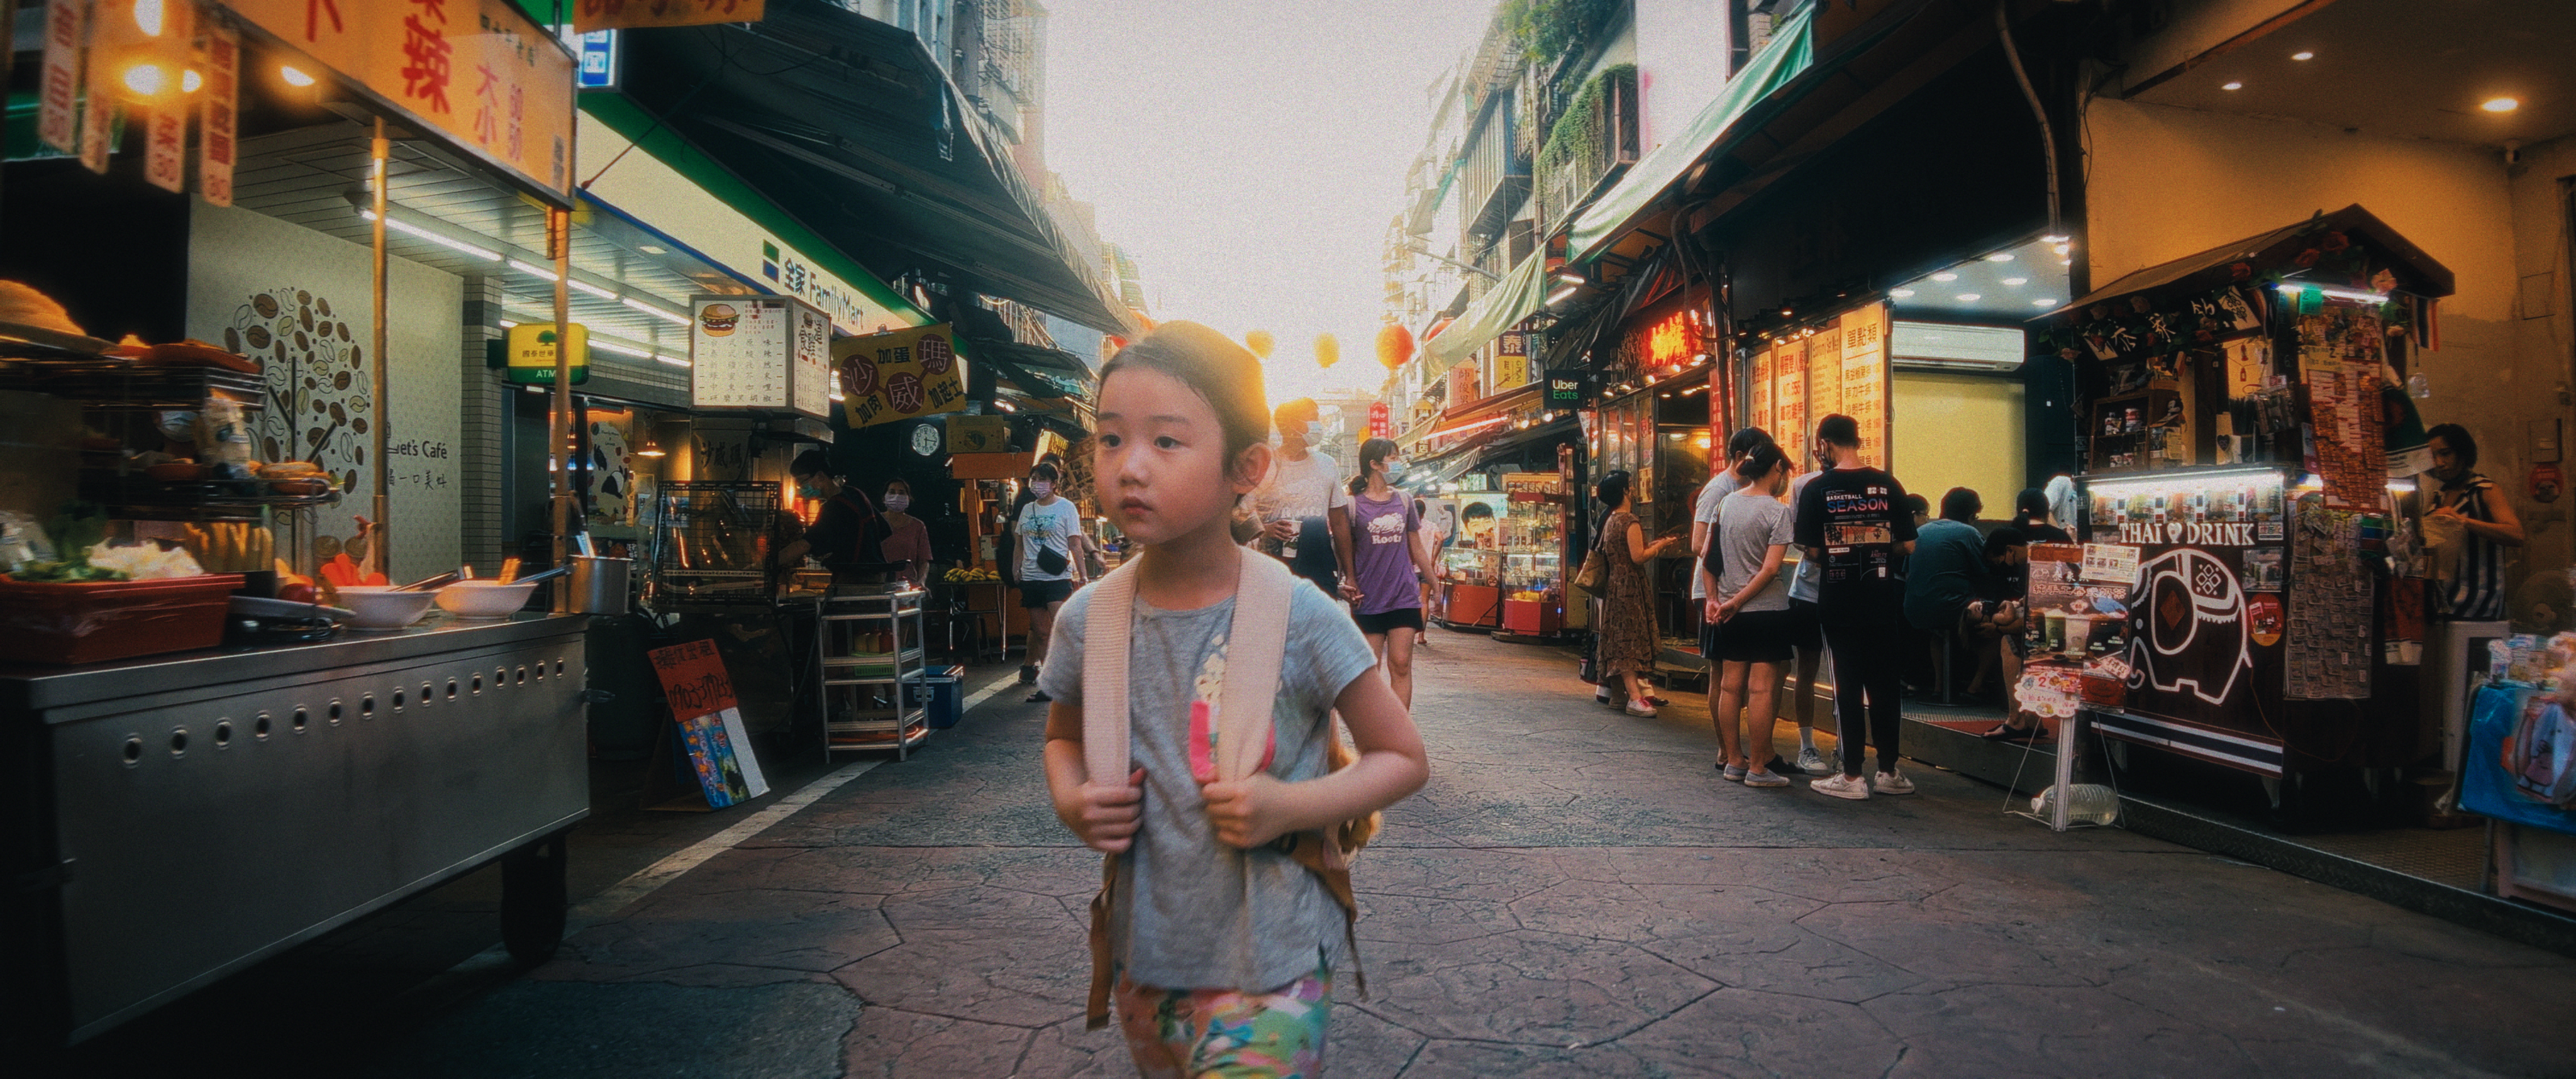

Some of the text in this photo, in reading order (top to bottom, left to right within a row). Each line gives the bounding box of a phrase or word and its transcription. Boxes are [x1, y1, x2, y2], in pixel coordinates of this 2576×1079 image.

[784, 257, 806, 297] 全家
[809, 272, 863, 330] FamilyMart
[1502, 335, 1522, 353] 泰
[876, 346, 911, 364] 加蛋
[536, 370, 557, 378] ATM
[928, 376, 963, 409] 加起士
[1552, 379, 1579, 389] Uber
[1553, 390, 1579, 400] Eats
[855, 394, 882, 424] 加肉
[422, 440, 447, 459] Café
[1827, 498, 1888, 513] SEASON
[2119, 521, 2255, 546] THAI DRINK
